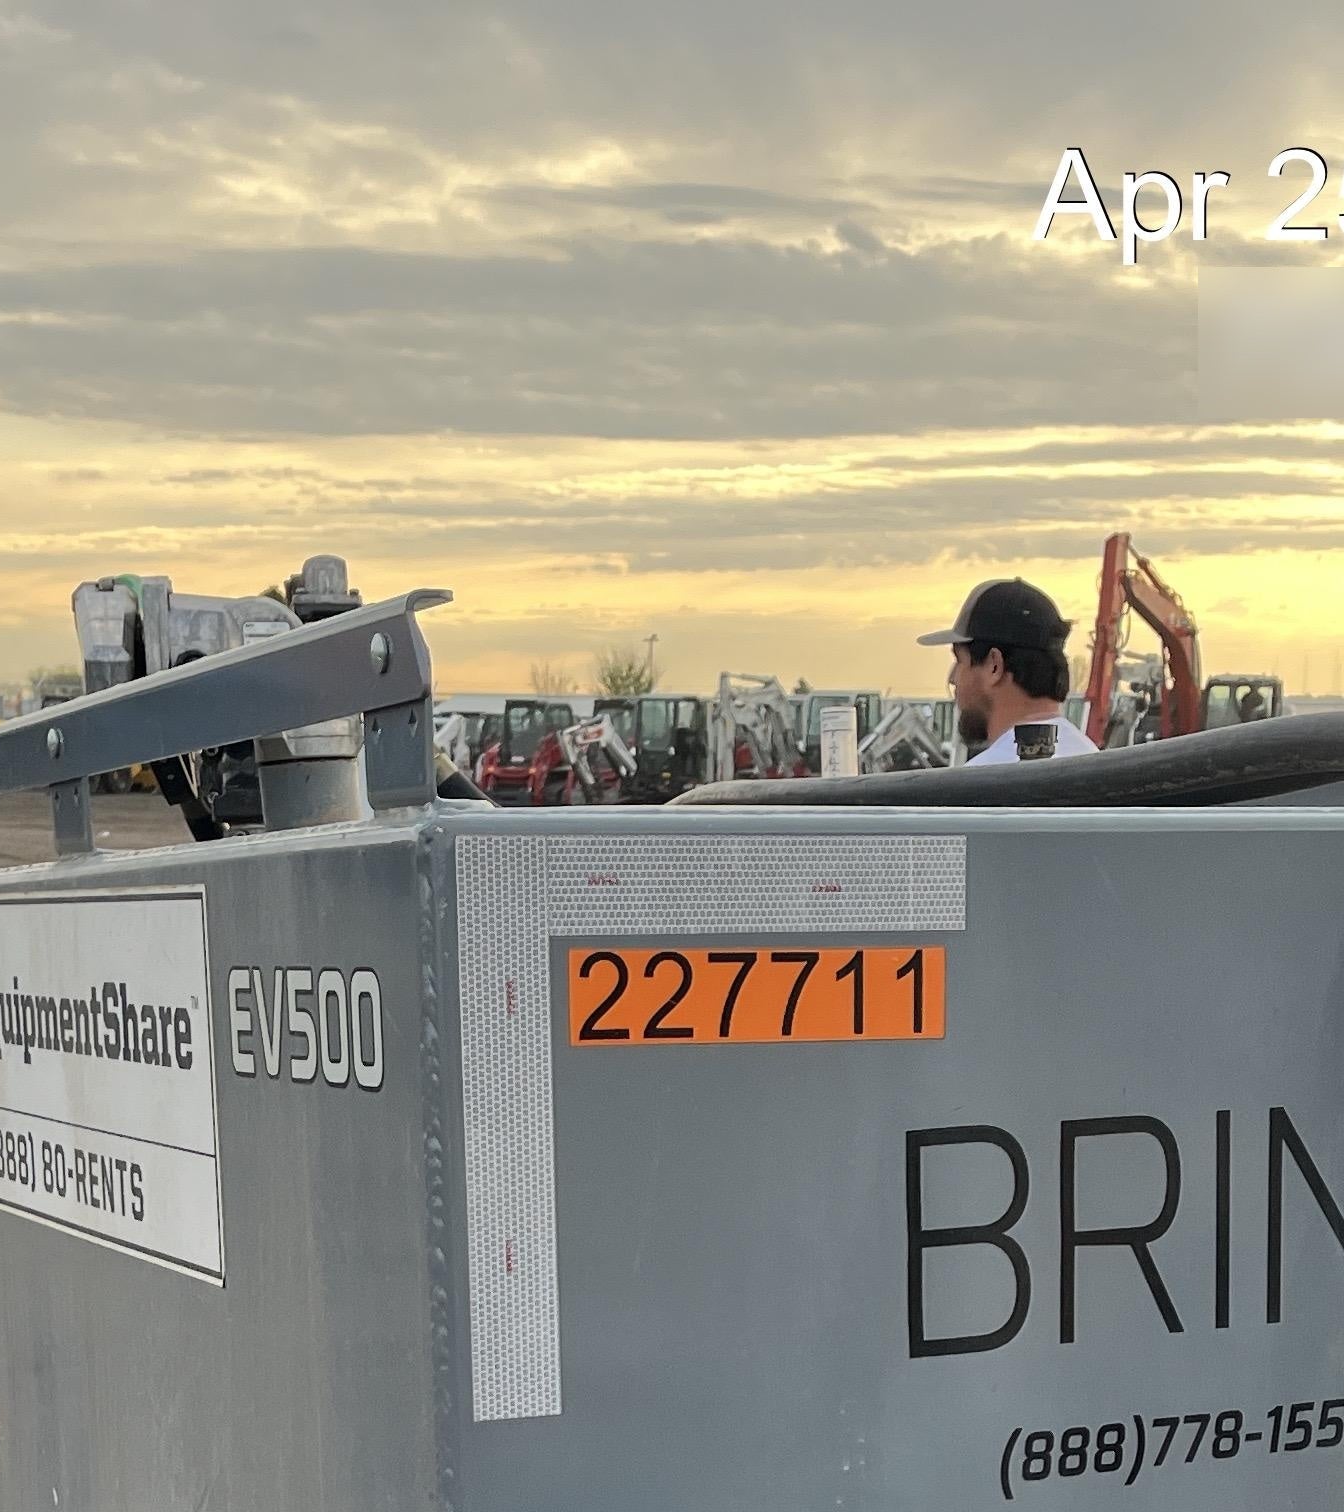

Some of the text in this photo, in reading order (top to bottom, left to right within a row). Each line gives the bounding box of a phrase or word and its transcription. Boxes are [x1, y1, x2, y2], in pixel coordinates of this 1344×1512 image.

[228, 966, 384, 1092] EV500
[579, 949, 923, 1041] 227711
[42, 1139, 145, 1222] 80-RENTS
